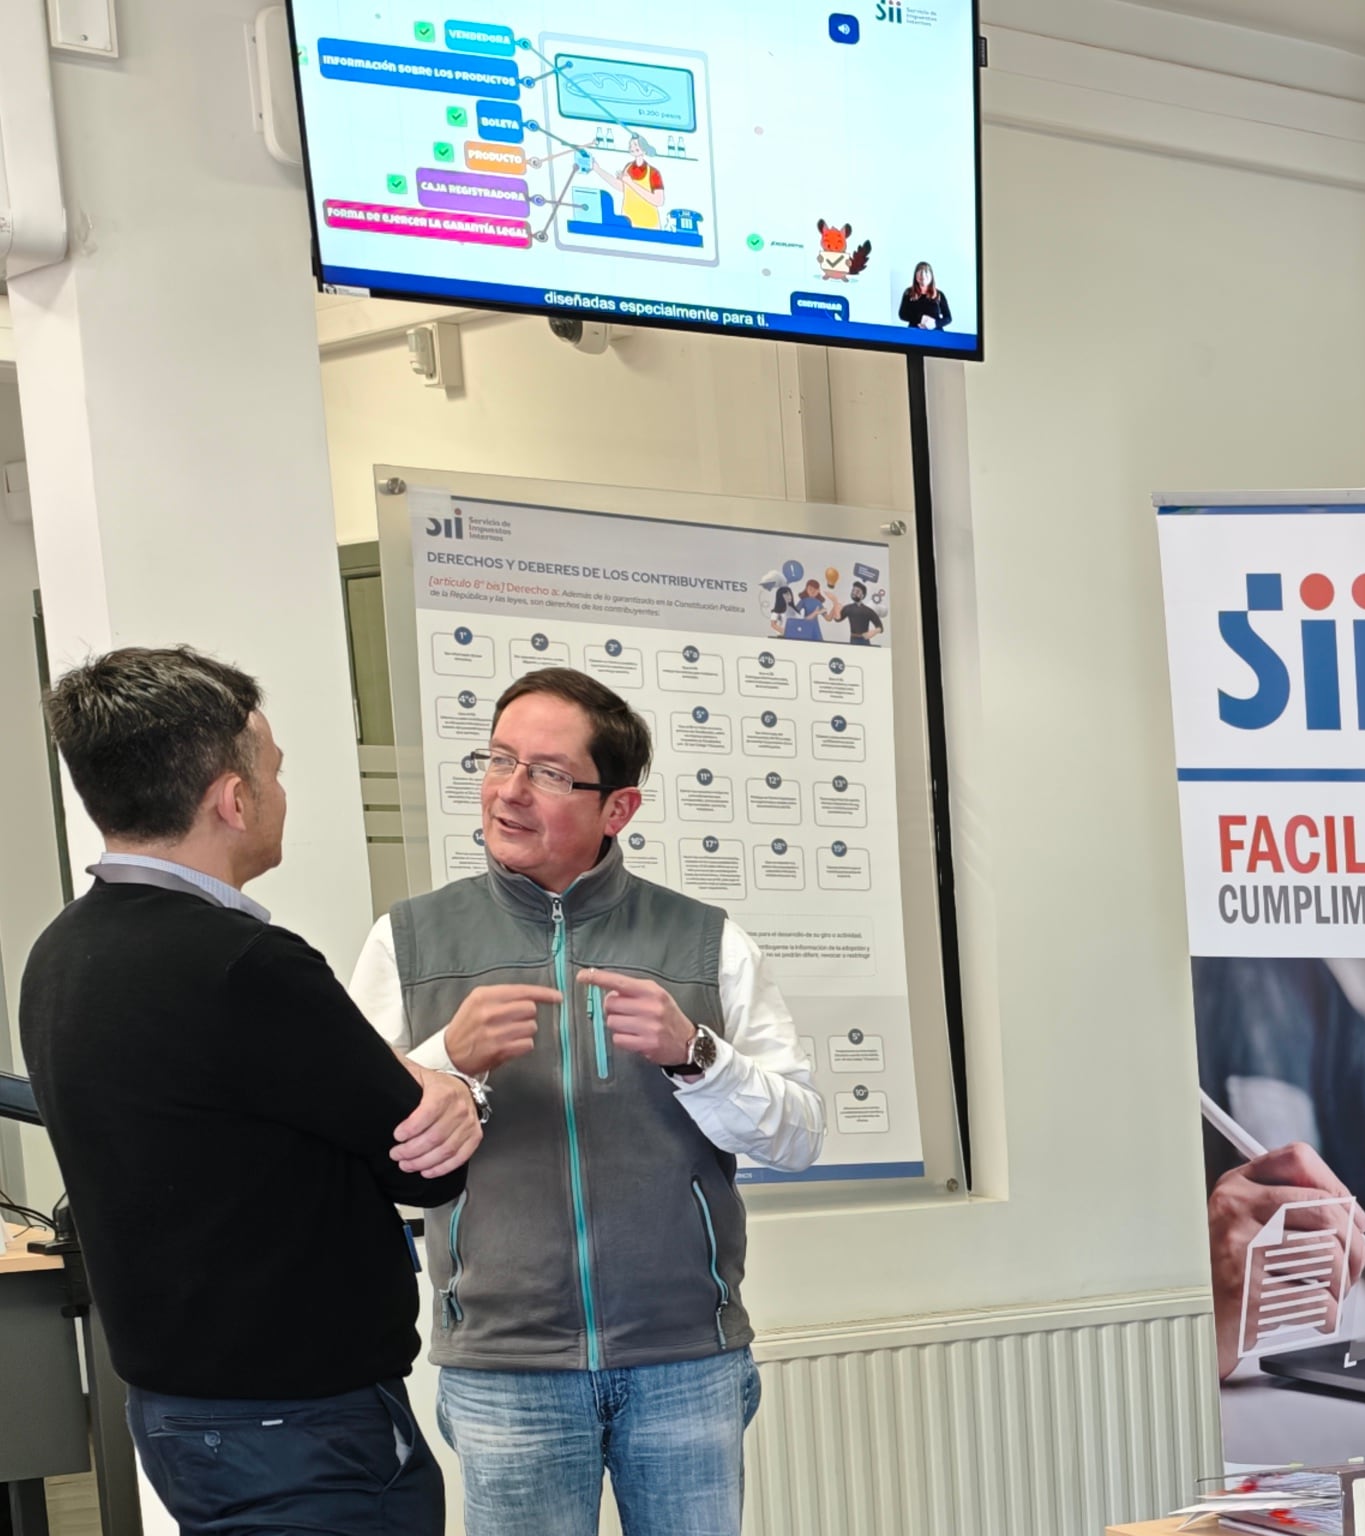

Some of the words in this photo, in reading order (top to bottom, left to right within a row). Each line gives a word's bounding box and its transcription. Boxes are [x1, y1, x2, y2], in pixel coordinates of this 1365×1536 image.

[449, 28, 511, 46] VENDEDORA
[322, 54, 396, 73] INFORMACIÓN
[434, 68, 453, 80] LOS
[455, 70, 516, 87] PRODUCTOS
[481, 117, 520, 131] BOLETA
[467, 149, 523, 164] PRODUCTO
[421, 181, 448, 193] CAJA
[448, 184, 526, 202] REGISTRADORA
[327, 206, 365, 220] FORMA
[429, 218, 441, 229] LA
[496, 226, 528, 239] LEGAL
[544, 291, 616, 310] diseñadas
[619, 300, 719, 322] especialmente
[722, 312, 754, 327] para
[756, 313, 770, 327] ti.
[468, 516, 501, 528] Servicio
[501, 519, 511, 528] de
[469, 524, 512, 536] Impuestos
[469, 531, 504, 542] Internos
[427, 551, 504, 570] DERECHOS
[505, 559, 517, 571] Y
[518, 560, 580, 577] DEBERES
[582, 566, 600, 579] DE
[602, 568, 629, 581] LOS
[631, 571, 748, 593] CONTRIBUYENTES
[506, 584, 549, 596] Derecho
[551, 588, 560, 596] a:
